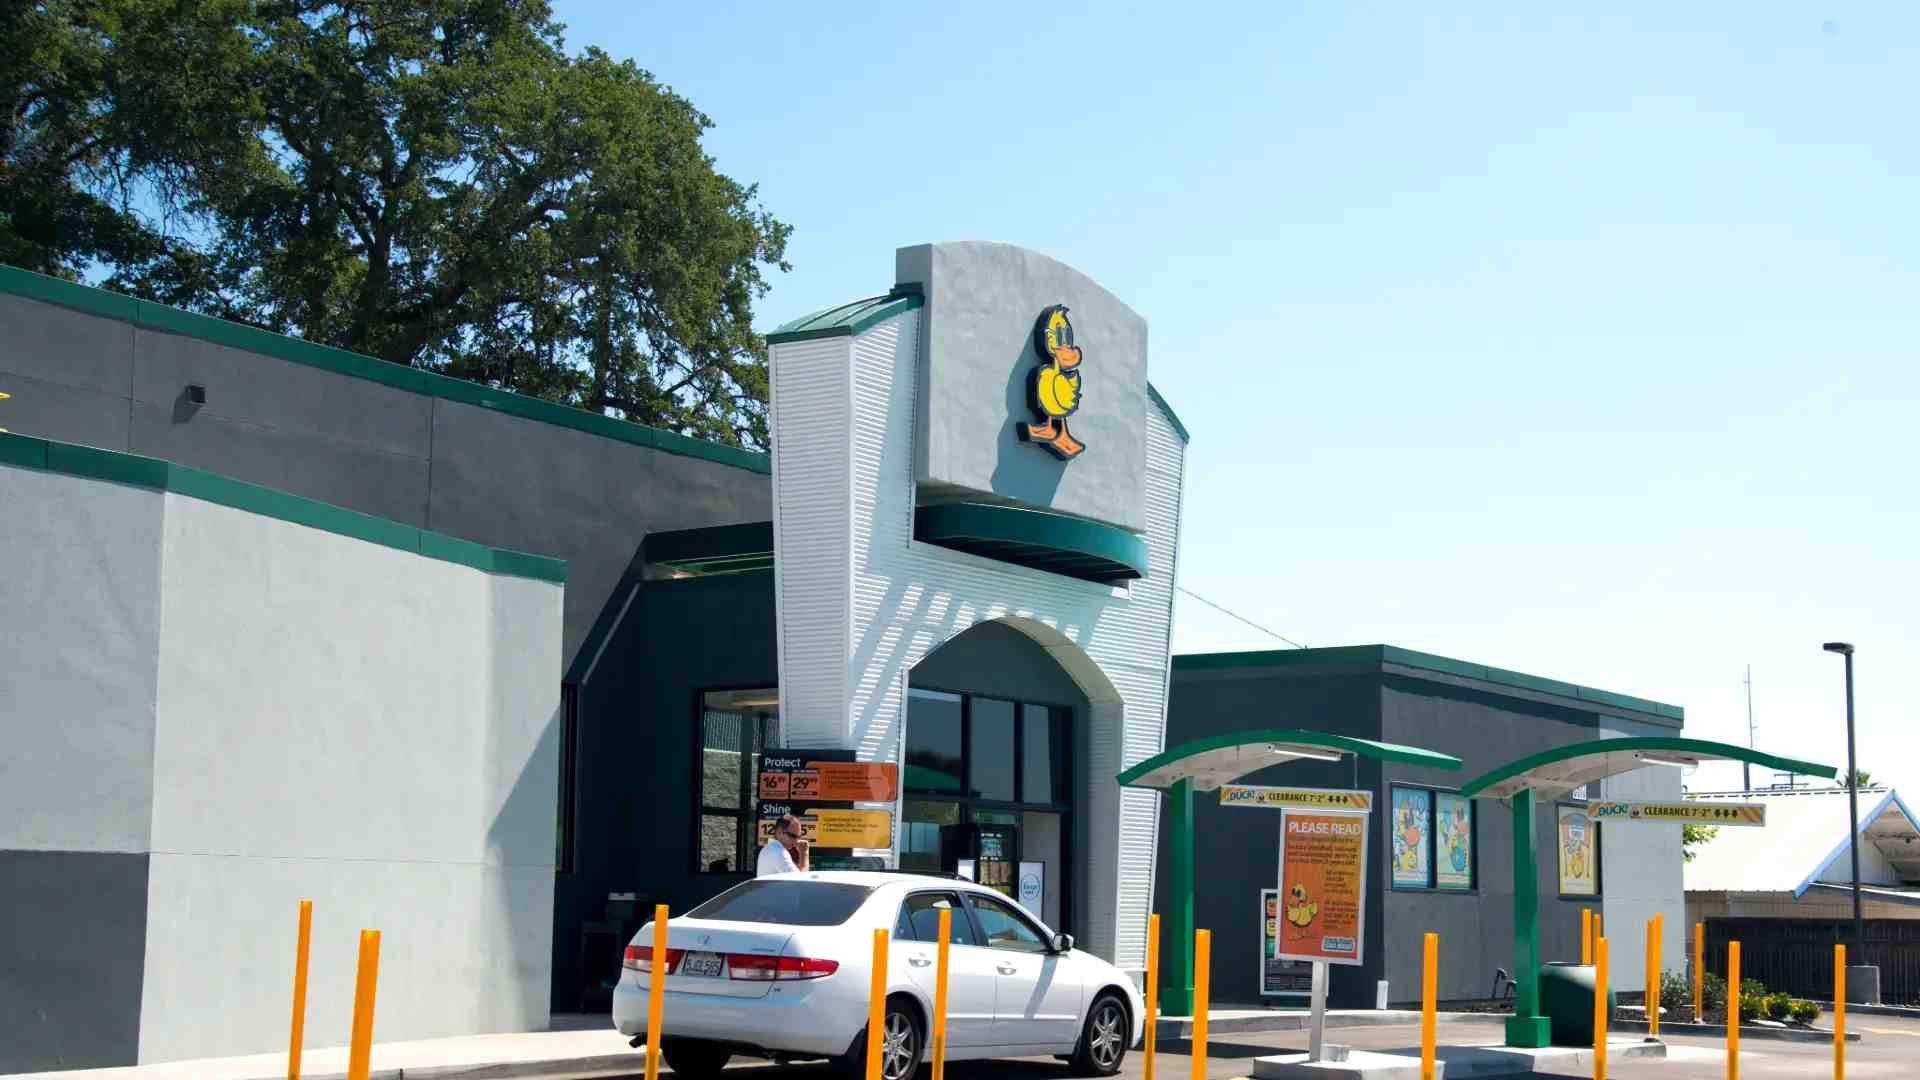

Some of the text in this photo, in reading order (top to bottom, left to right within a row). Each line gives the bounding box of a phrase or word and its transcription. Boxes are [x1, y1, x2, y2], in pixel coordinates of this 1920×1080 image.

[764, 757, 801, 767] Protect
[1268, 792, 1307, 803] CLEARANCE
[762, 803, 791, 814] Shine
[1598, 803, 1629, 816] DUCK!
[1643, 805, 1690, 817] CLEARANCE
[1288, 821, 1361, 834] PLEASE READ
